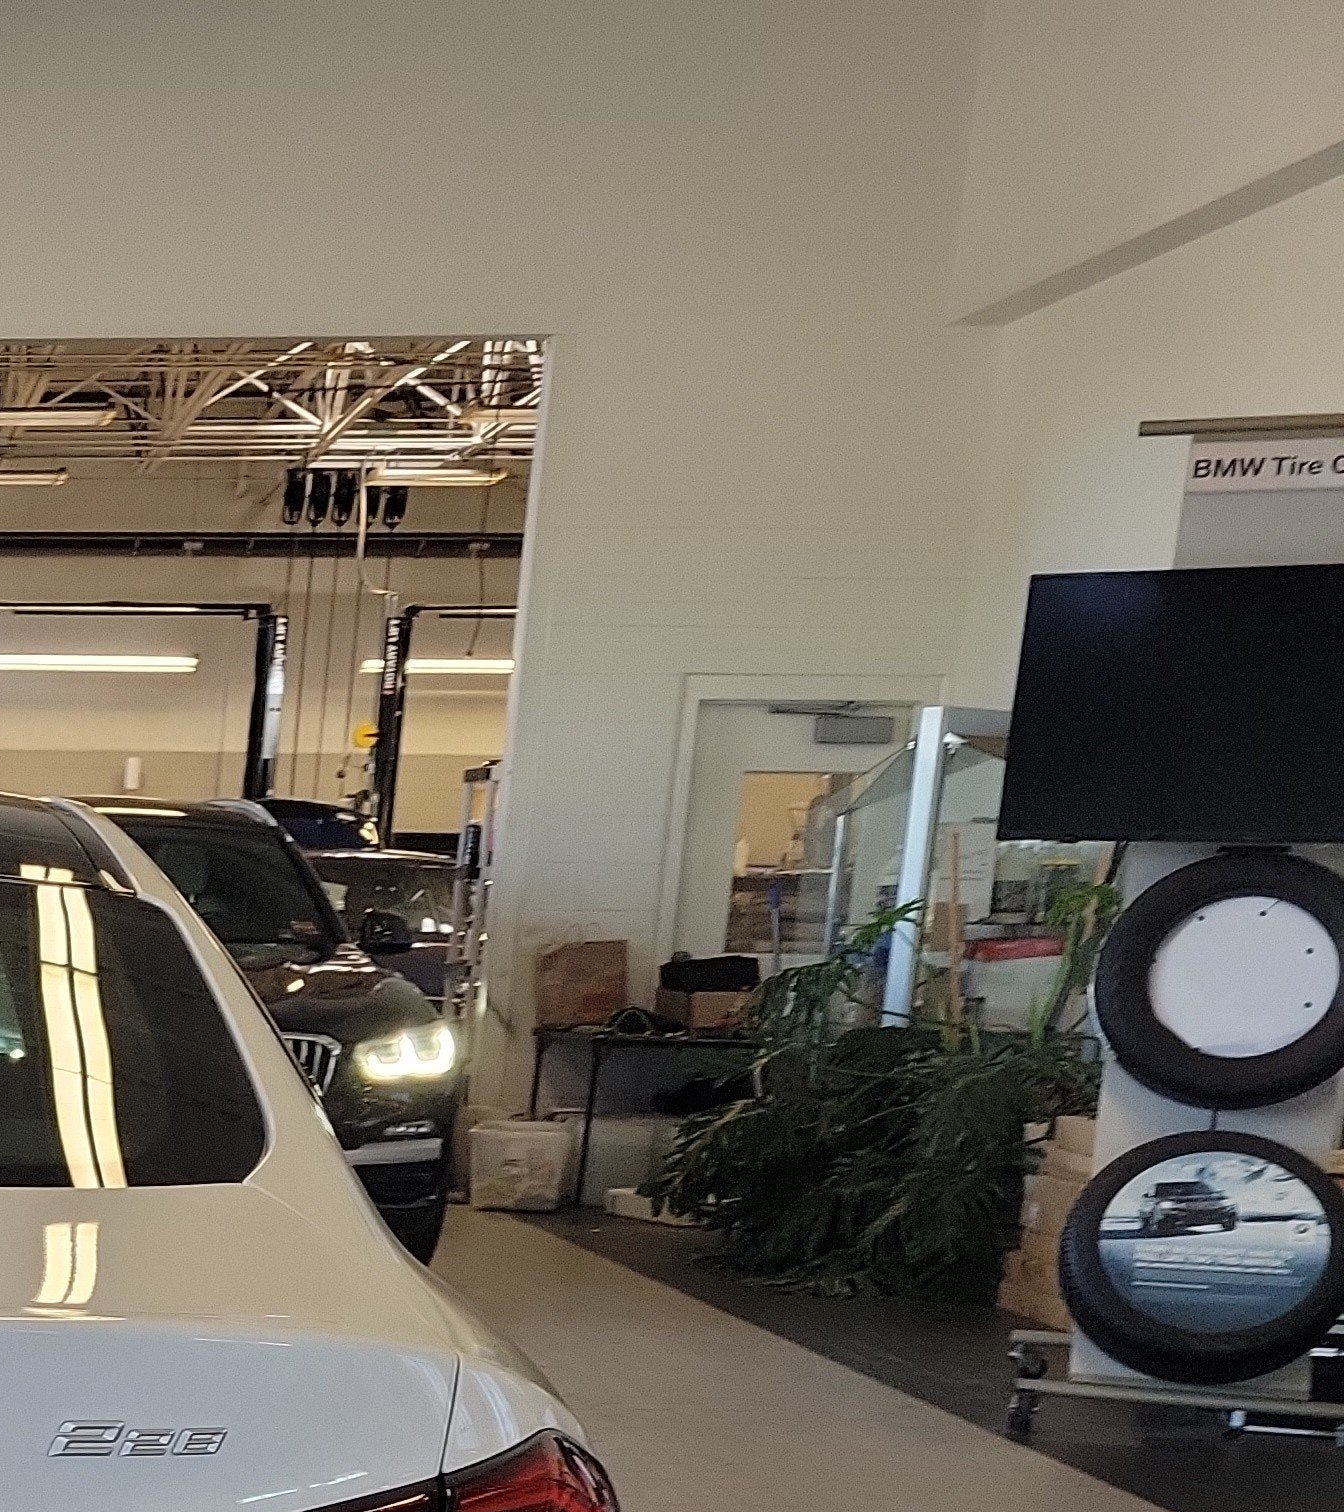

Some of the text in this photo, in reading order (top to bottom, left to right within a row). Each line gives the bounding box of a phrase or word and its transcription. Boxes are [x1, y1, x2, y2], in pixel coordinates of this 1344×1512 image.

[1193, 457, 1266, 478] BMW
[1271, 455, 1323, 476] Tire
[47, 1419, 228, 1457] 228
